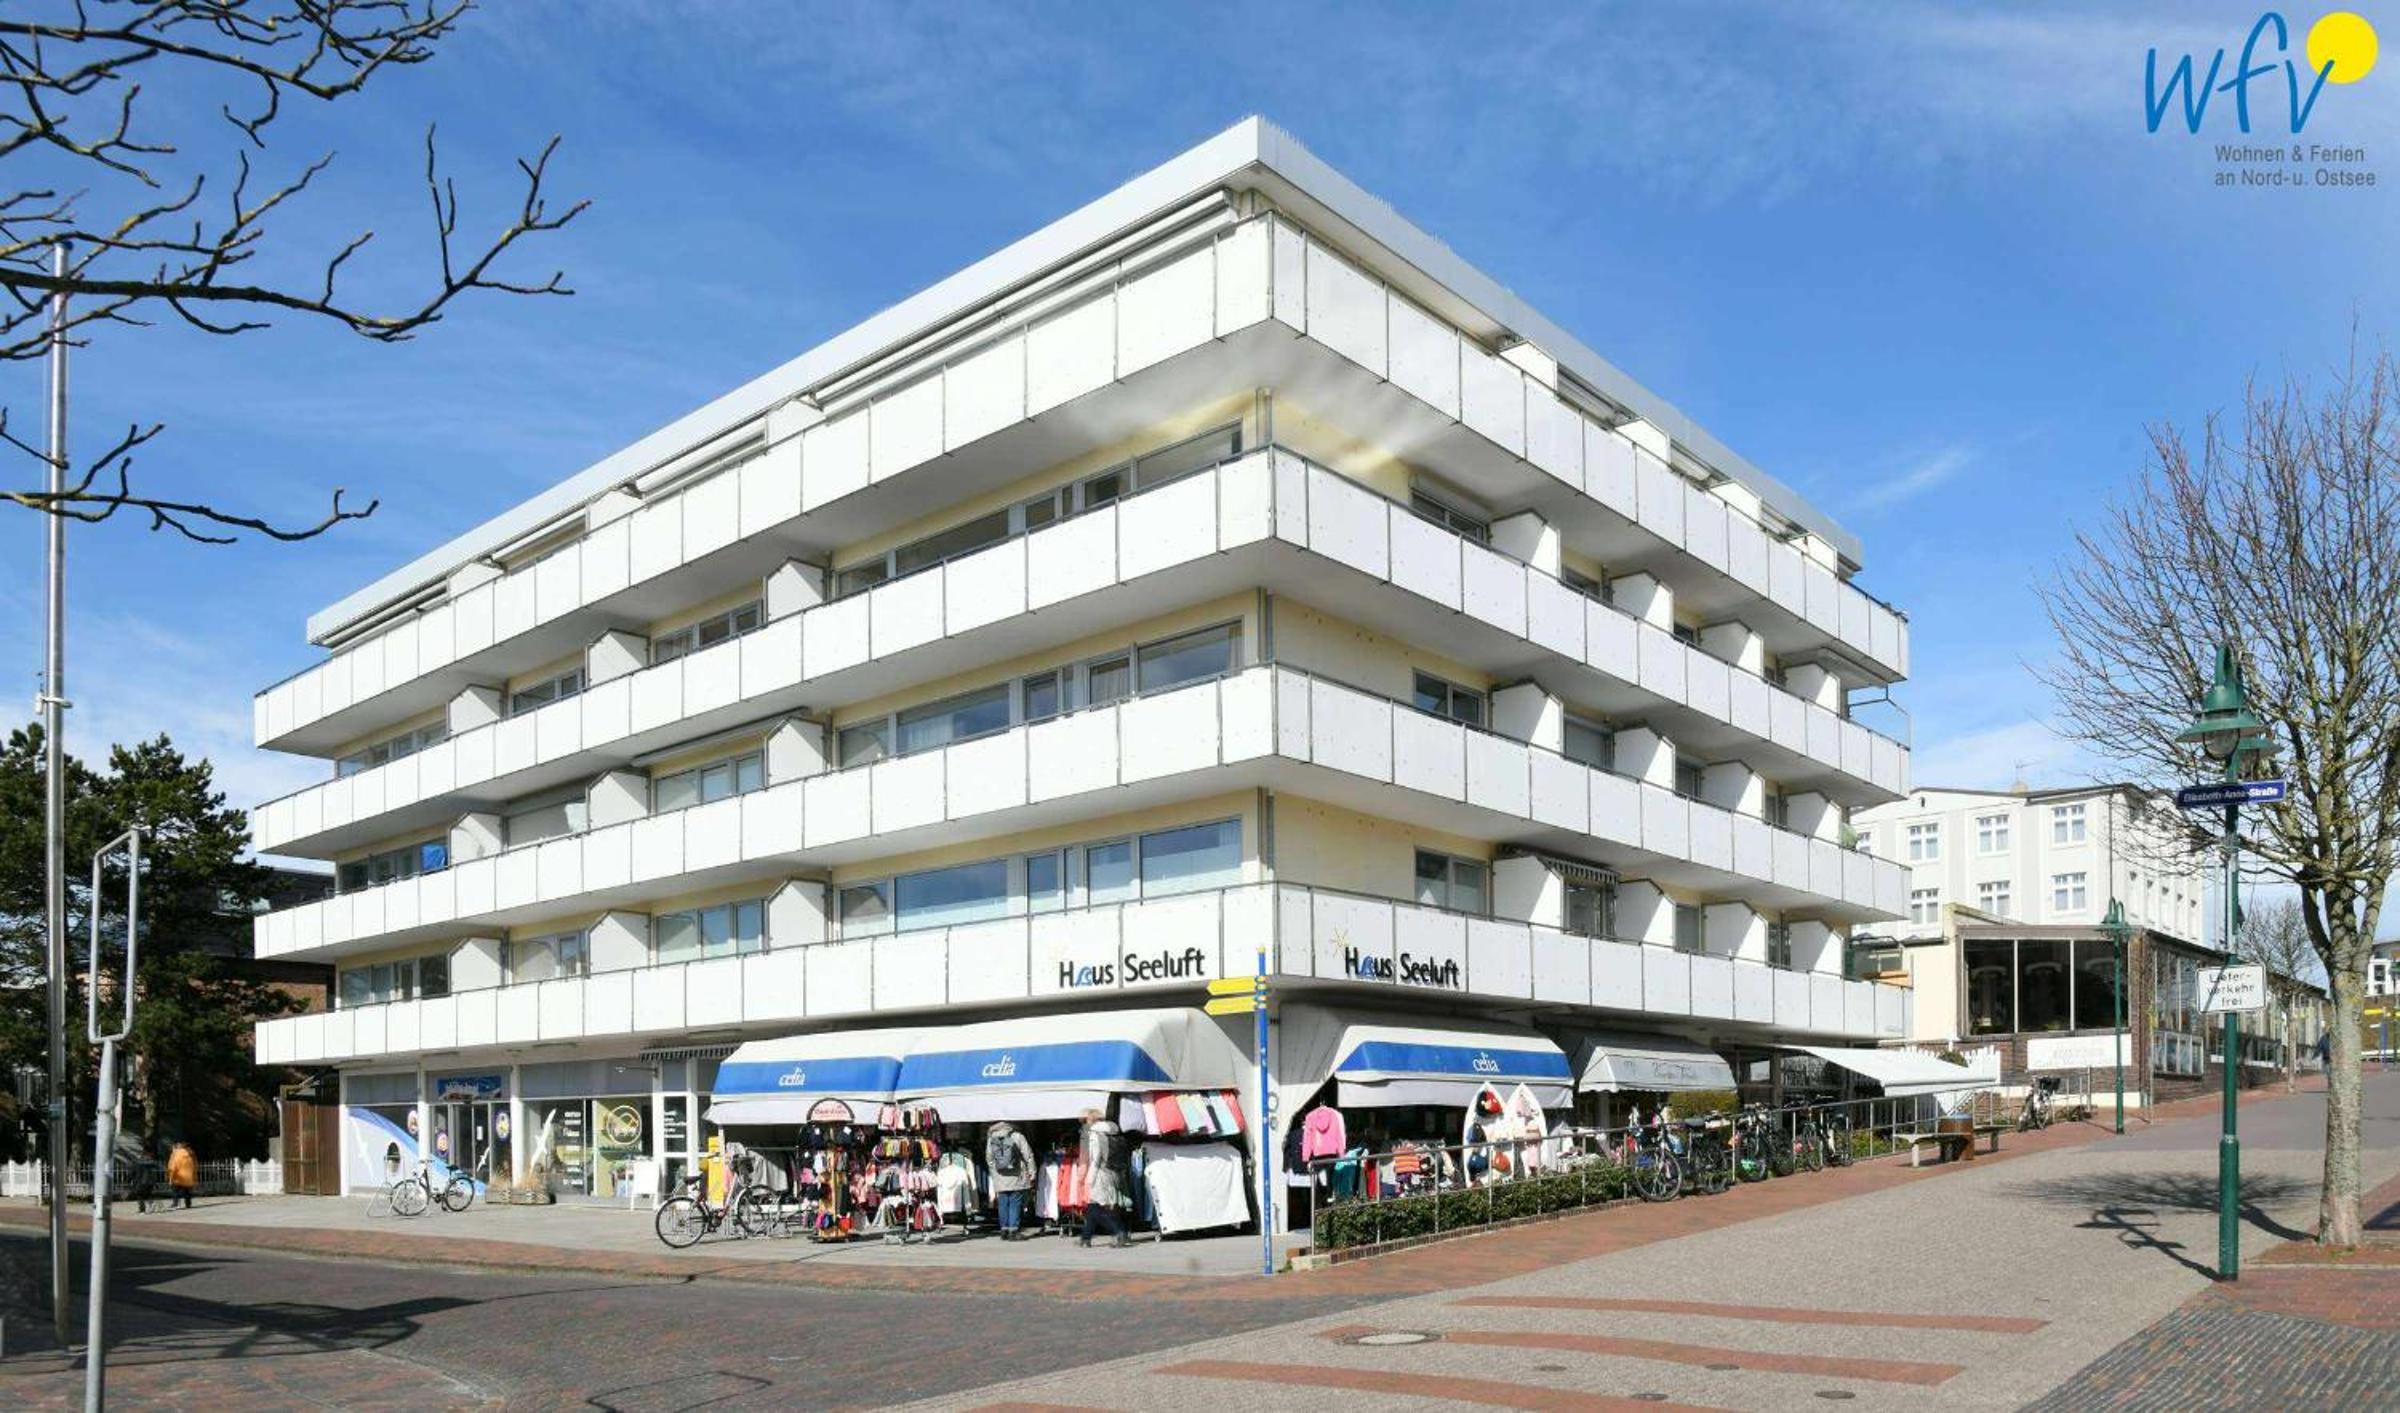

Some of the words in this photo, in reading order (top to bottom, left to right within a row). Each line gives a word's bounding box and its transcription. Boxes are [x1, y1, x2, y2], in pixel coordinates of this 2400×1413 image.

[1059, 961, 1114, 988] Haus
[1124, 947, 1206, 982] Seeluft
[1345, 946, 1393, 979] Haus
[1400, 953, 1459, 987] Seeluft
